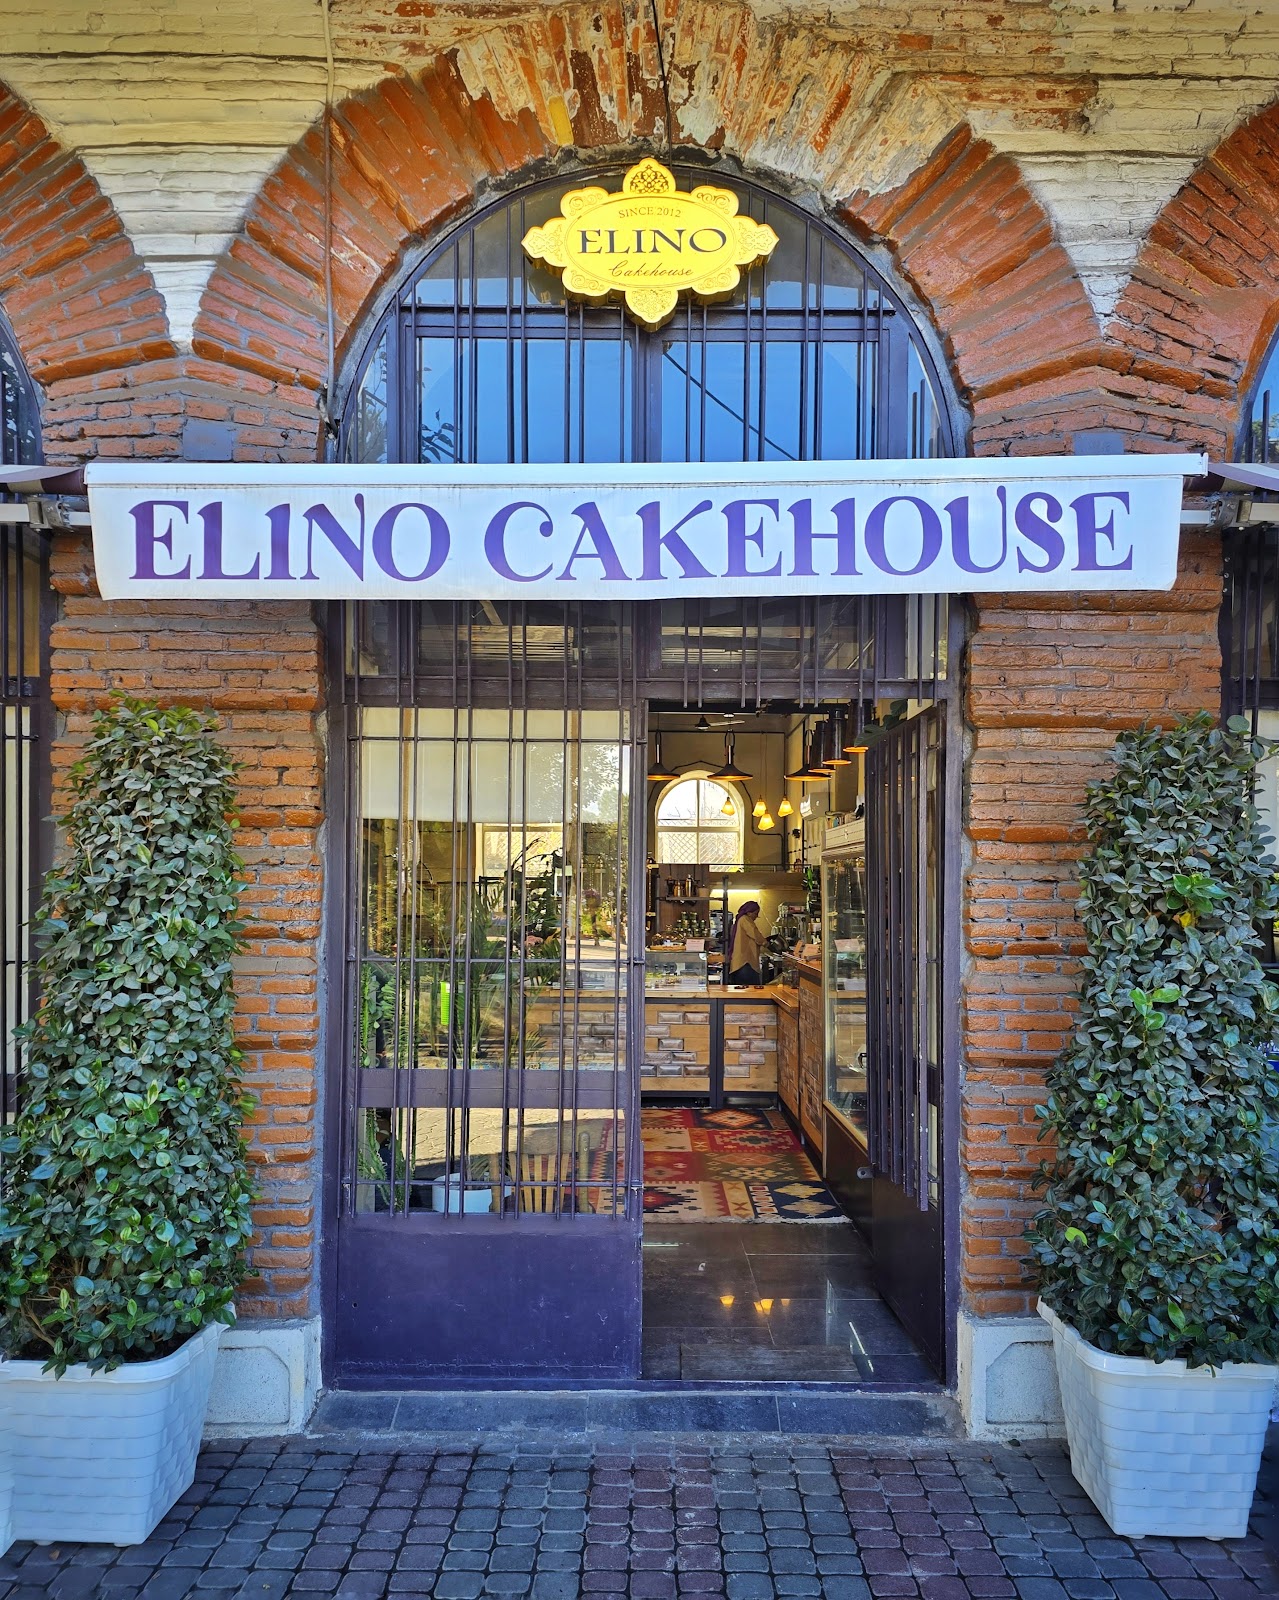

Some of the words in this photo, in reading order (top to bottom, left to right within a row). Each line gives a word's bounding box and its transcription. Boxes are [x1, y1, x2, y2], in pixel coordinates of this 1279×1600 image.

[618, 206, 654, 218] SINCE
[656, 207, 681, 218] 2012
[577, 228, 727, 254] ELINO
[608, 259, 694, 277] Cakehouse
[129, 493, 450, 582] ELINO
[484, 485, 1134, 582] CAKEHOUSE
